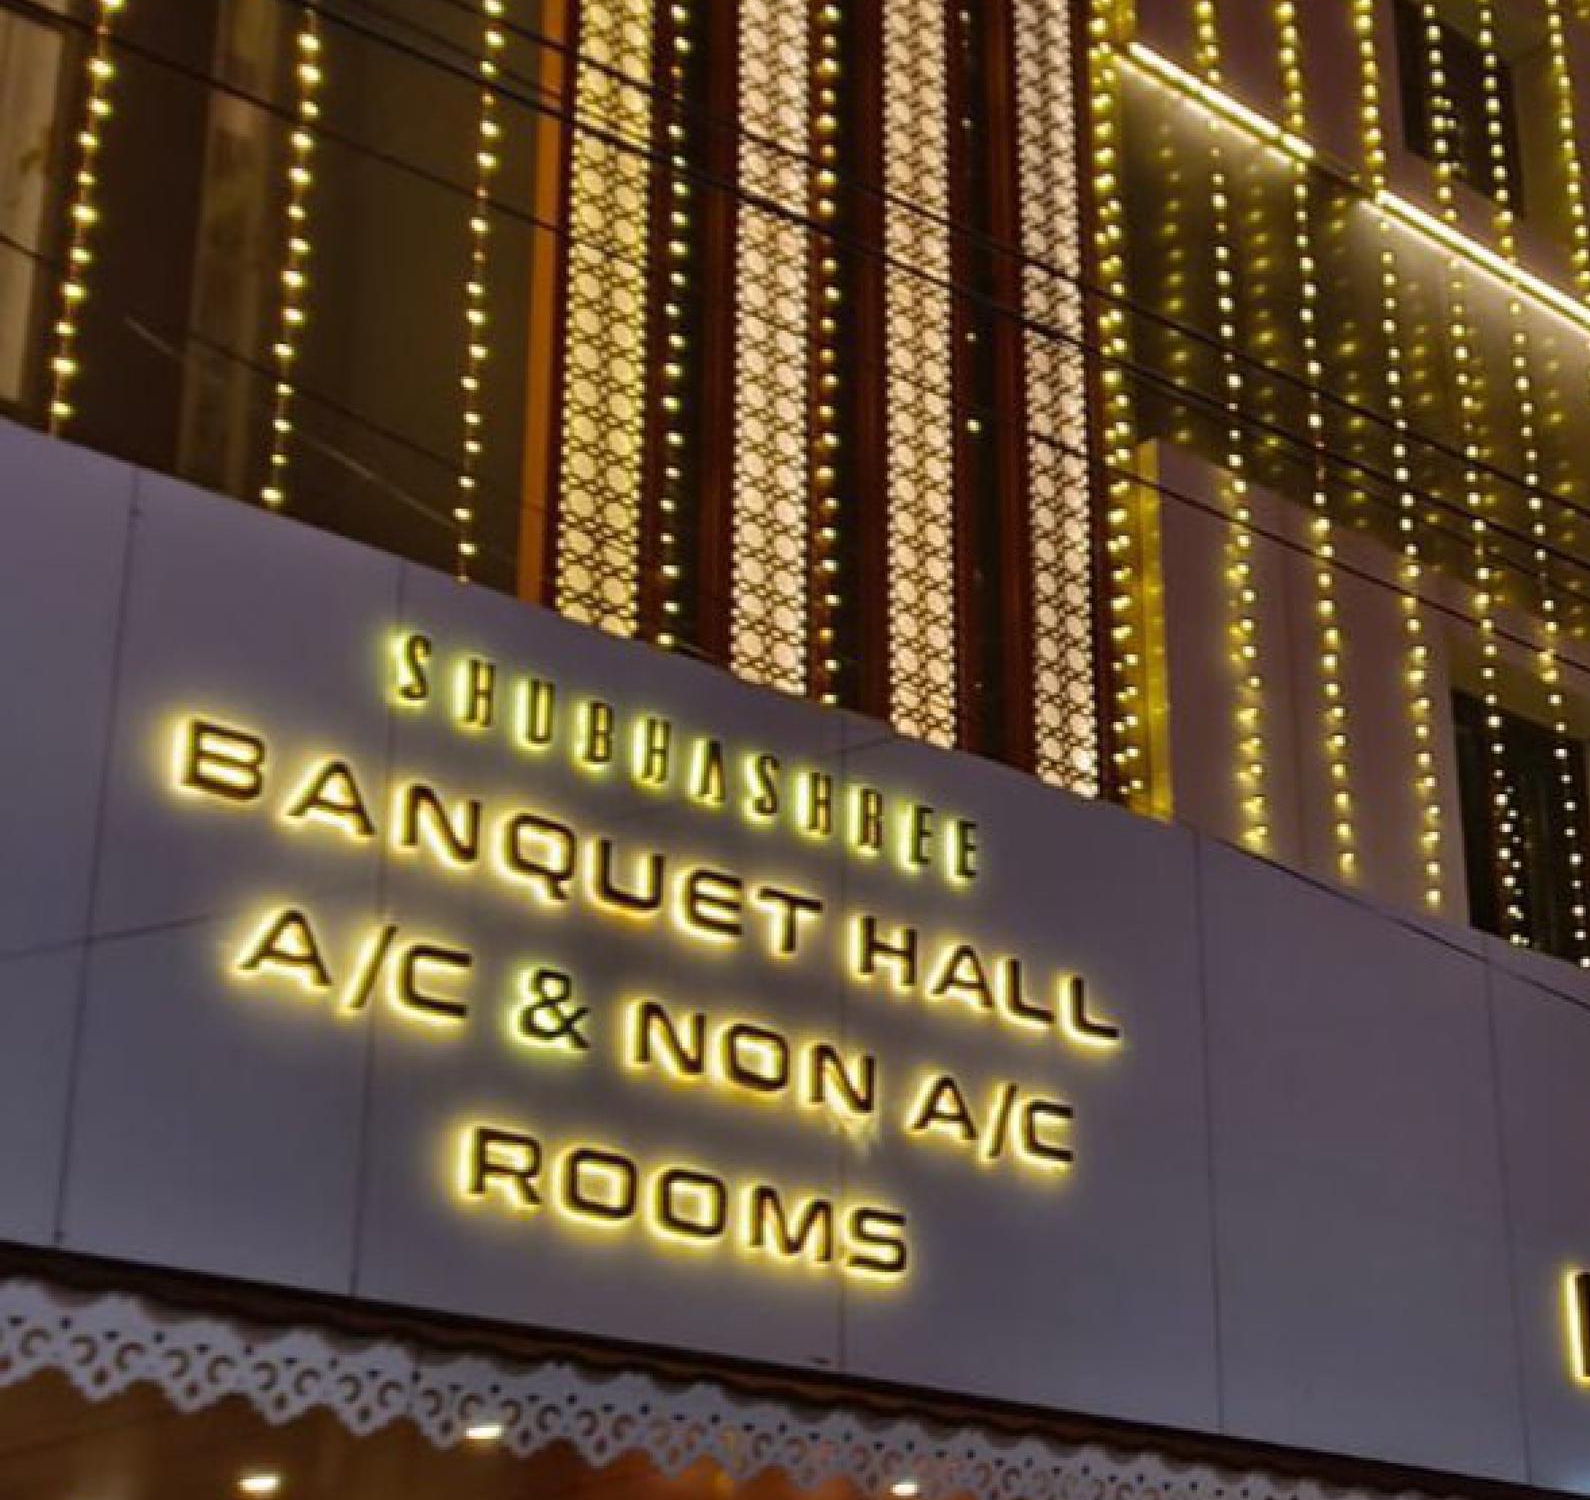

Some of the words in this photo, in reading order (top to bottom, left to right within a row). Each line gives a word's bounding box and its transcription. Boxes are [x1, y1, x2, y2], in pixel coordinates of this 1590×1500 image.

[182, 719, 822, 955] BANQUET
[858, 914, 1121, 1041] HALL
[396, 632, 979, 881] SHUBHASHREE
[240, 907, 474, 1020] A/C
[519, 968, 592, 1051] &
[634, 1000, 876, 1115] NON
[911, 1074, 1076, 1164] A/C
[469, 1126, 908, 1277] ROOMS
